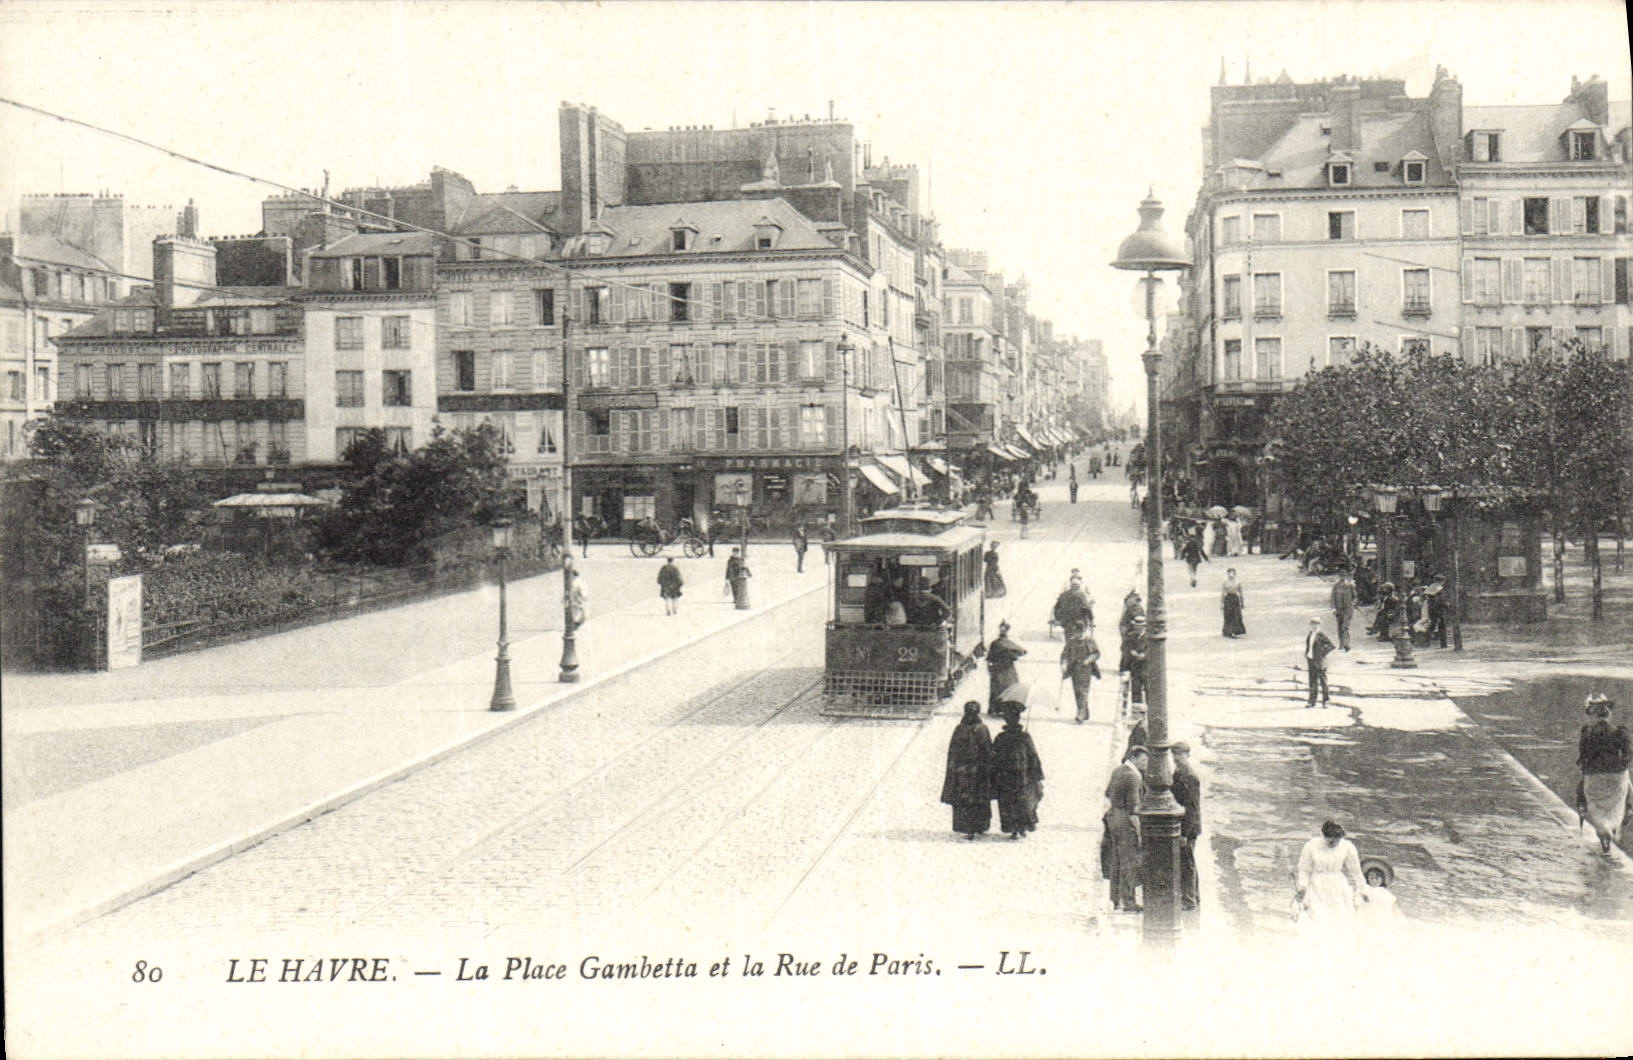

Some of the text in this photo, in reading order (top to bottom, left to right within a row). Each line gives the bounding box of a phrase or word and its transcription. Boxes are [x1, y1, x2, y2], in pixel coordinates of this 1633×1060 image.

[174, 343, 290, 354] PHOTOGRAPHIE CENTRALE
[725, 454, 823, 468] PHARMACIE
